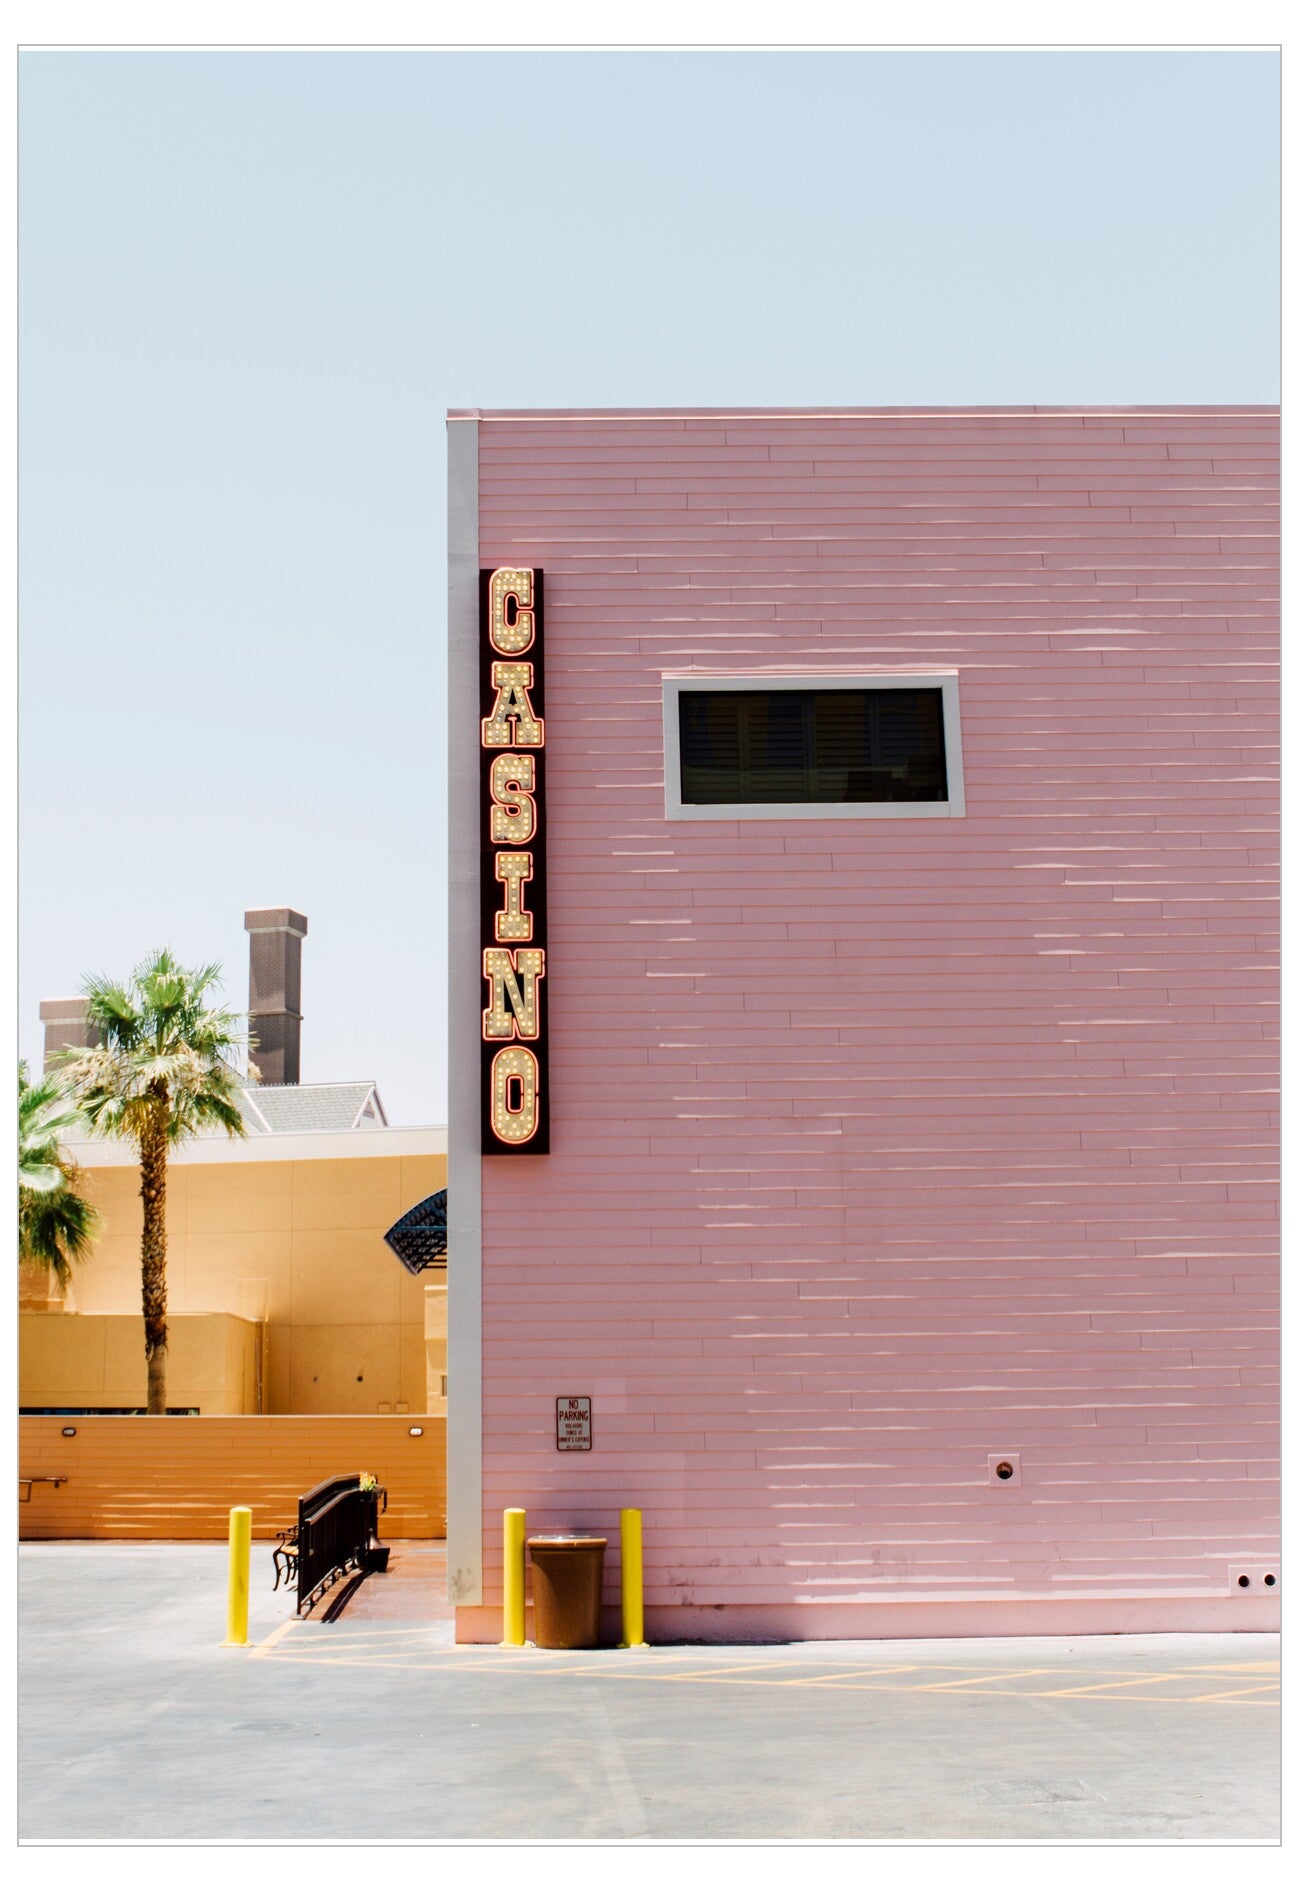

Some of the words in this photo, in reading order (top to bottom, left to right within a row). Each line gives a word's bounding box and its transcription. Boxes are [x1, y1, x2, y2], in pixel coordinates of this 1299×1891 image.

[481, 567, 545, 1144] CASINO
[568, 1399, 579, 1409] NO
[559, 1410, 589, 1421] PARKING
